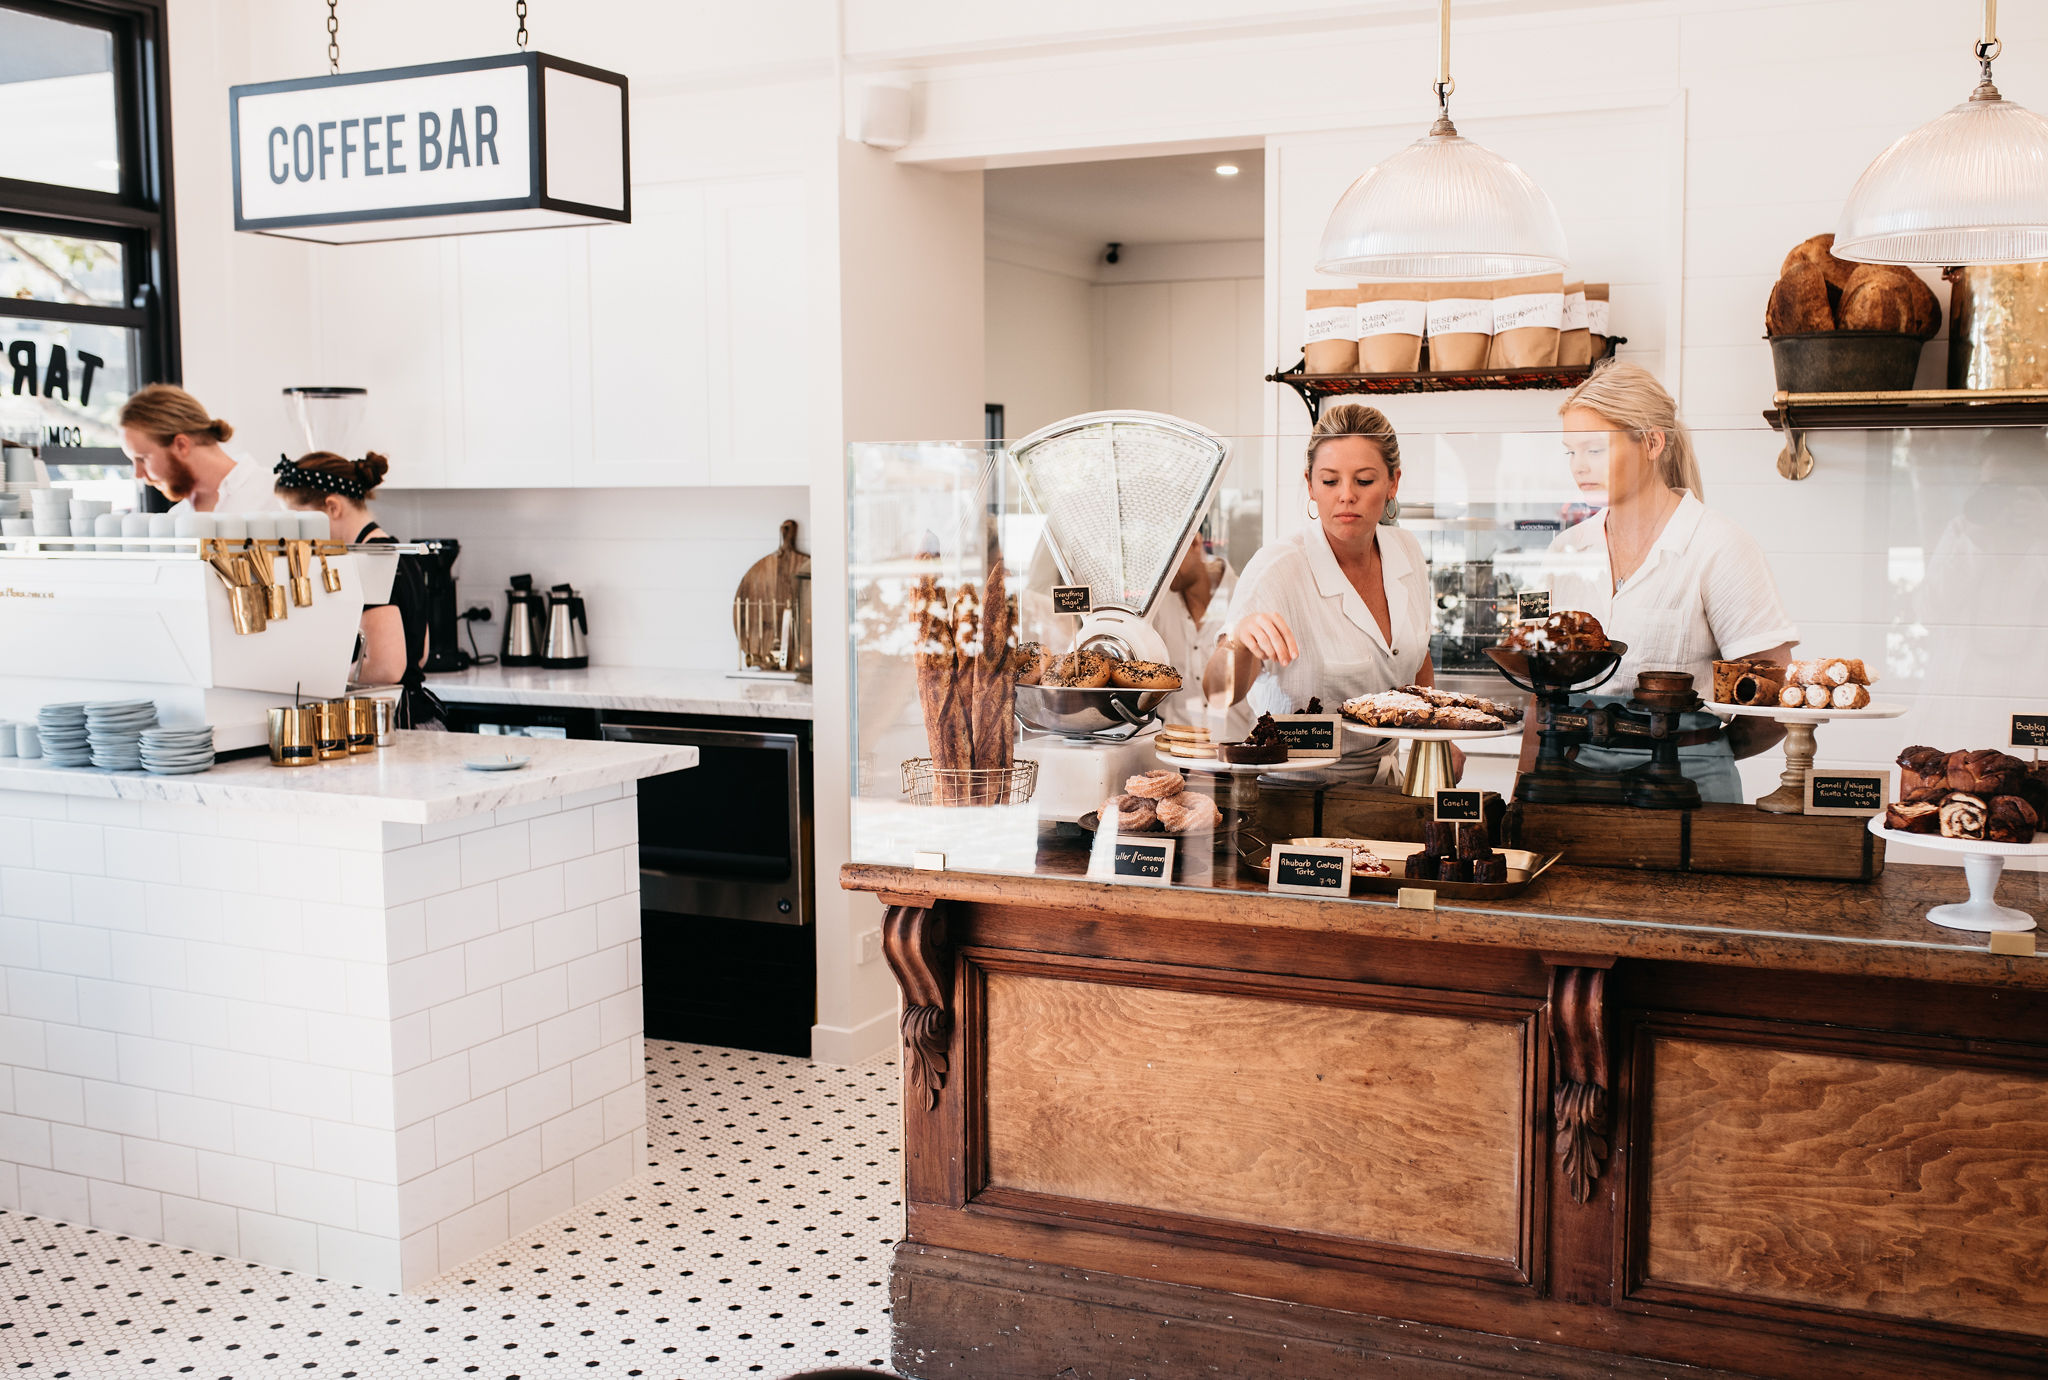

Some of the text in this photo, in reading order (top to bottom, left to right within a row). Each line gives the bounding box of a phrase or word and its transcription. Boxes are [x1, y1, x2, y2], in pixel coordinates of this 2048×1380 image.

[268, 105, 500, 185] COFFEE BAR
[1054, 590, 1084, 601] Everything
[1061, 599, 1079, 609] Bagel
[1311, 726, 1332, 736] Praline
[2016, 721, 2046, 732] Babka
[1114, 852, 1131, 861] uller
[1280, 857, 1342, 871] Rhubarb Custard
[1294, 867, 1316, 876] Tarte
